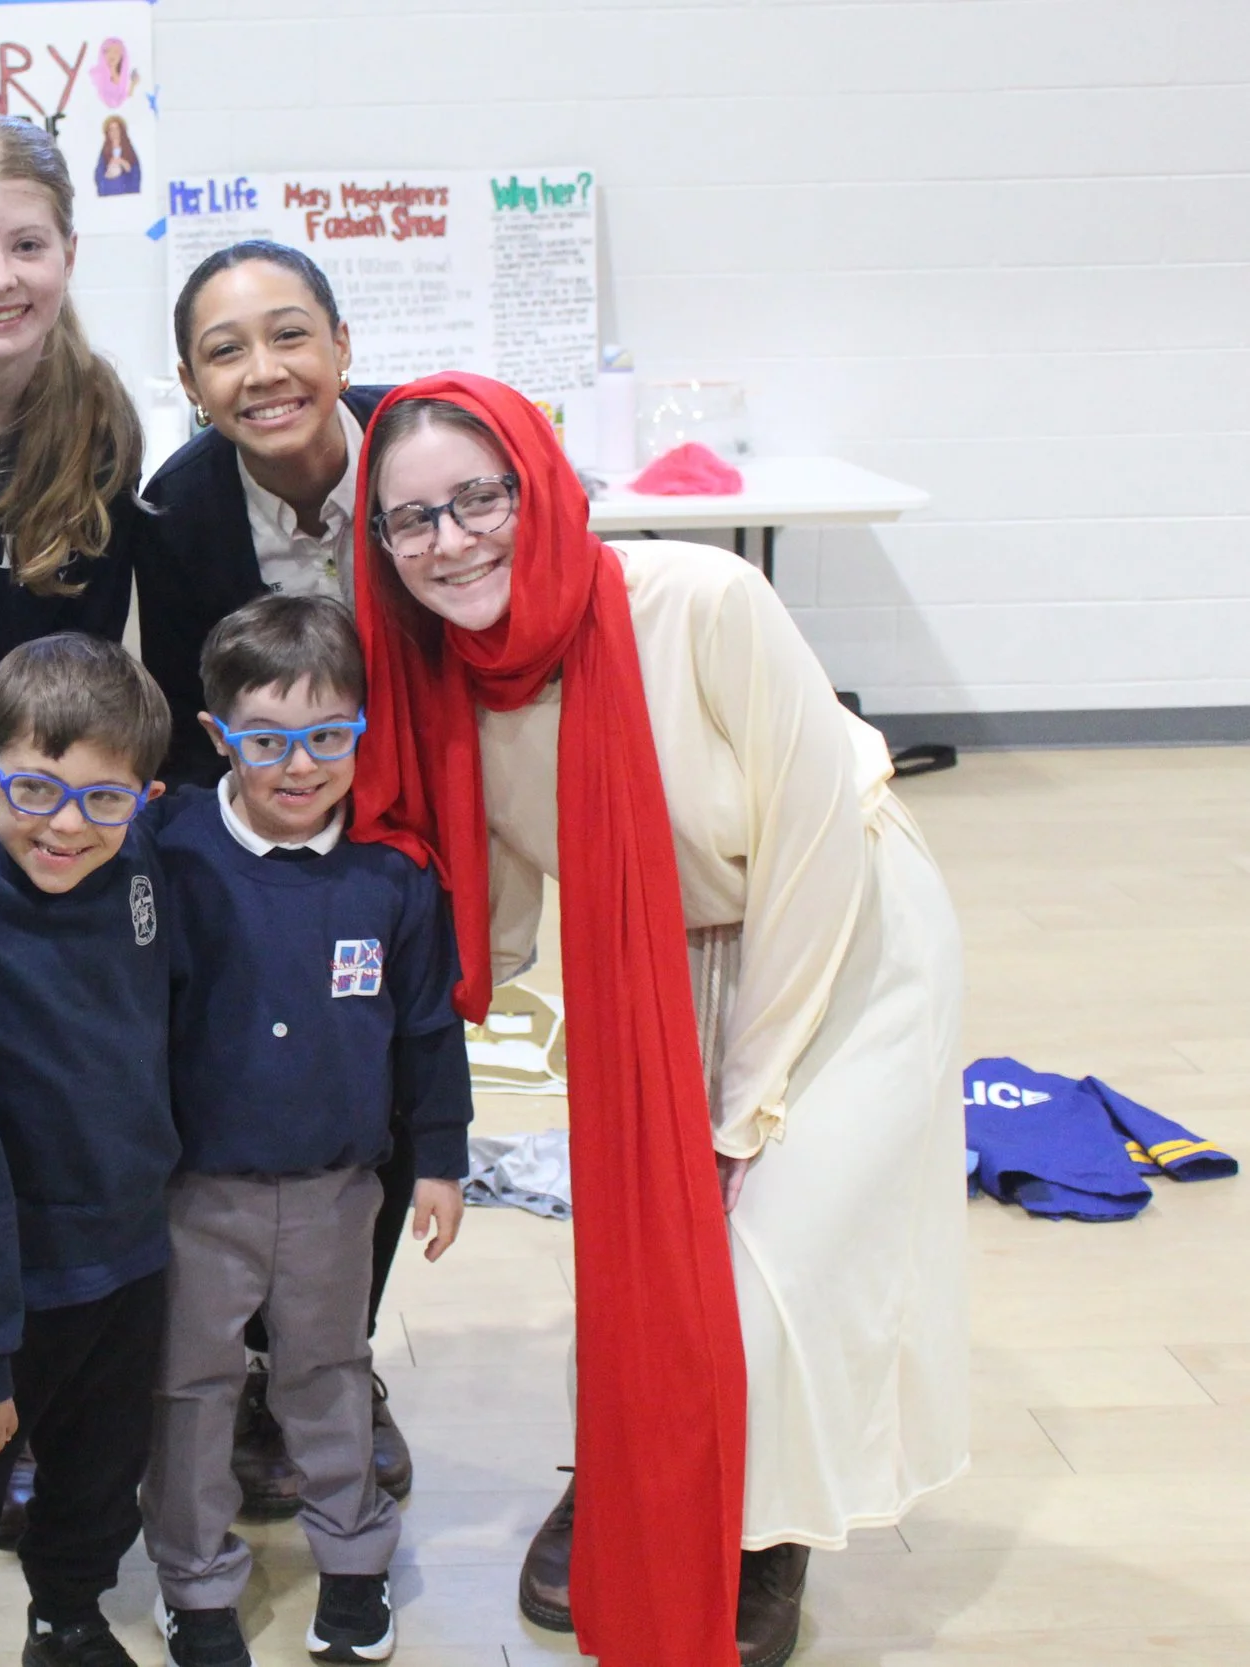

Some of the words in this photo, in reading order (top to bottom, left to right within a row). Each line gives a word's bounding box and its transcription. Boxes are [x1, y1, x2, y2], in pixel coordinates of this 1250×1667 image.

[170, 180, 204, 215] Her
[208, 176, 258, 212] Life
[284, 182, 330, 210] Mary
[491, 175, 538, 213] Why
[305, 210, 386, 242] Fashion
[391, 206, 446, 241] Show
